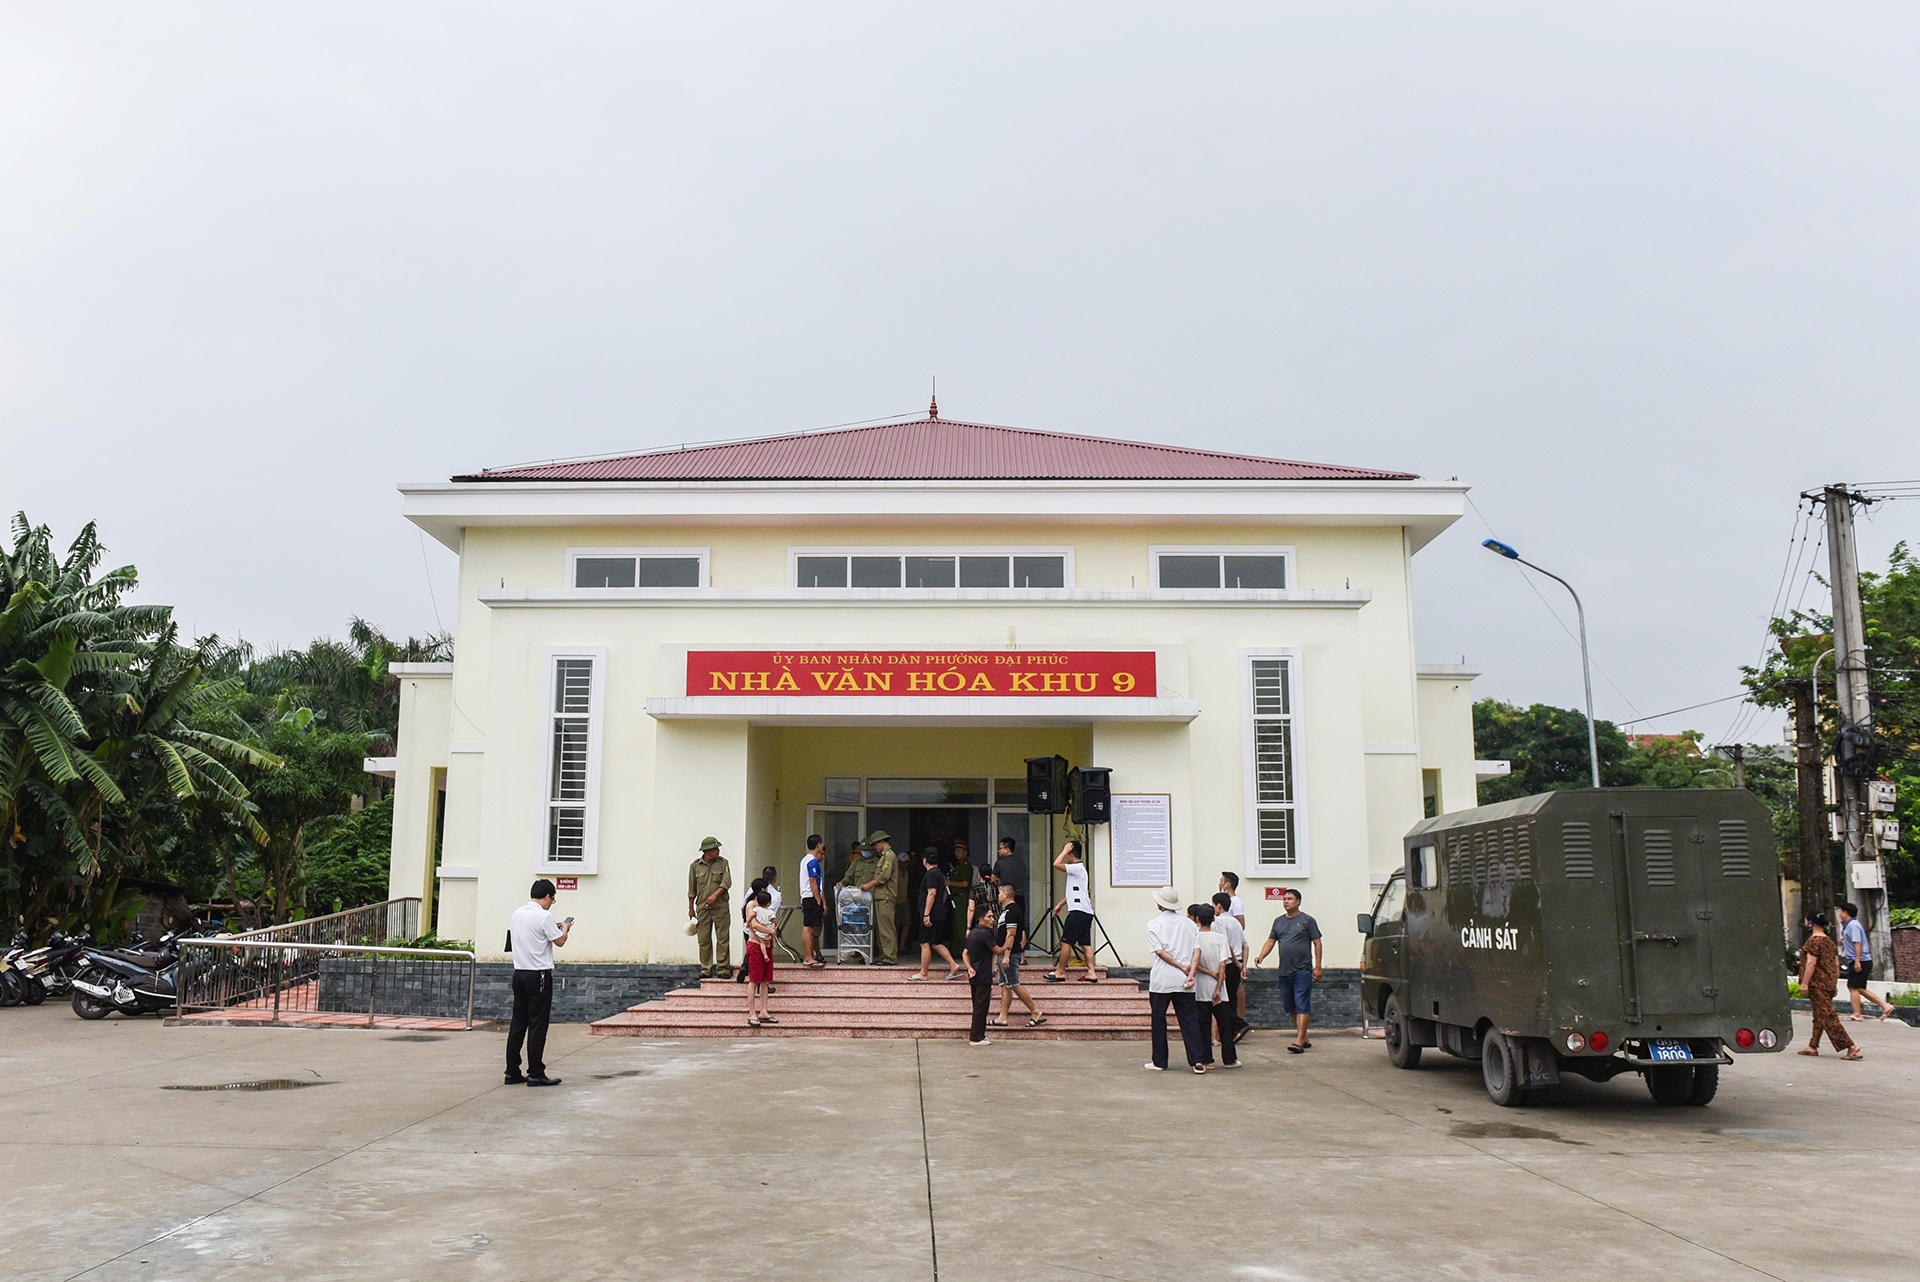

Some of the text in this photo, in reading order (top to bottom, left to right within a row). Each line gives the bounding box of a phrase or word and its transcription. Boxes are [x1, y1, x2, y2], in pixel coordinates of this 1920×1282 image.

[773, 651, 1068, 667] ỦY BAN NHÂN DÂN PHƯỜNG ĐẠI PHÚC
[709, 665, 1136, 693] NHÀ VĂN HÓA KHU 9
[1461, 918, 1519, 951] CẢNH SÁT
